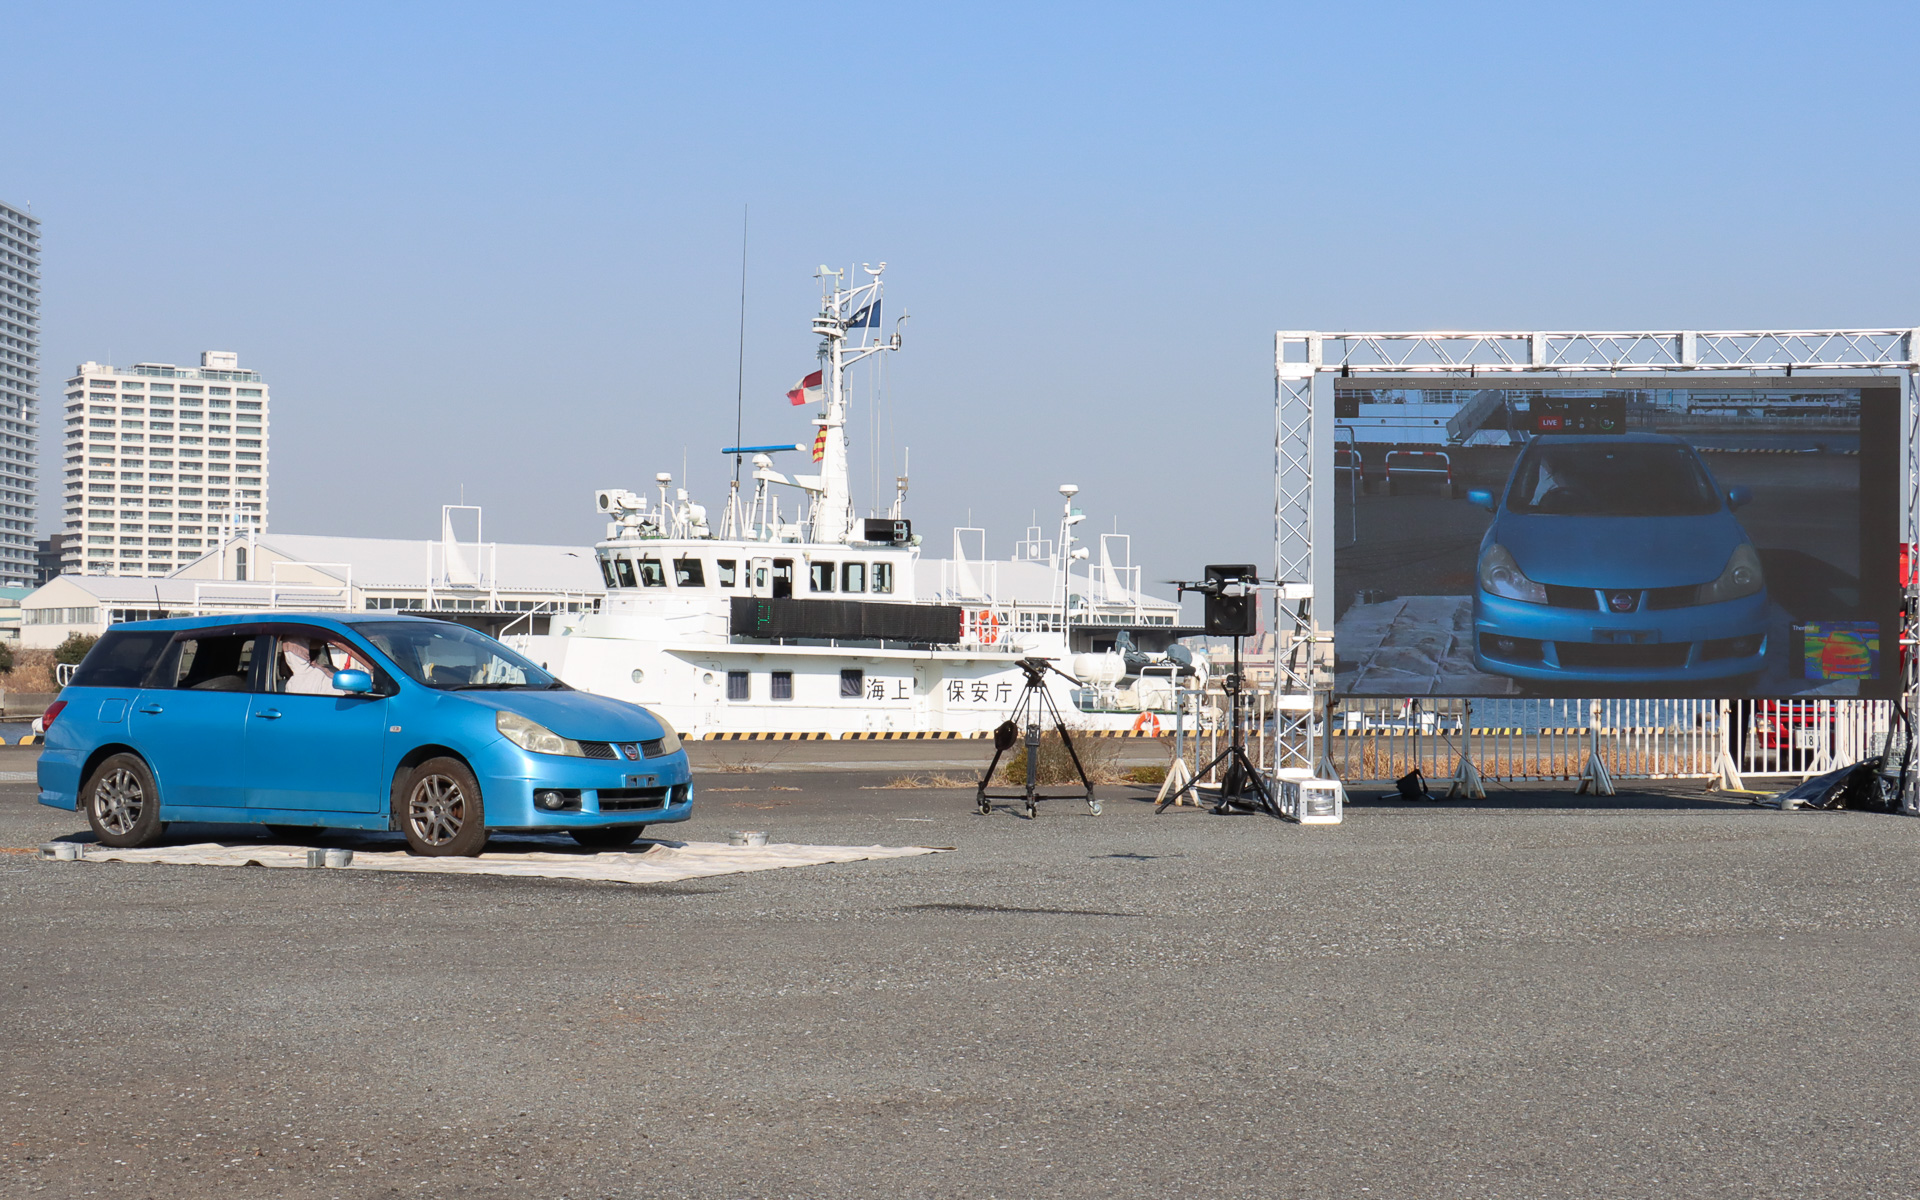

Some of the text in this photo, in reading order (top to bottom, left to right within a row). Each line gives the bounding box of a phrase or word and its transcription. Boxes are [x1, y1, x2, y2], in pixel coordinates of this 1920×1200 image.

[866, 678, 1013, 704] 海上 保安庁
